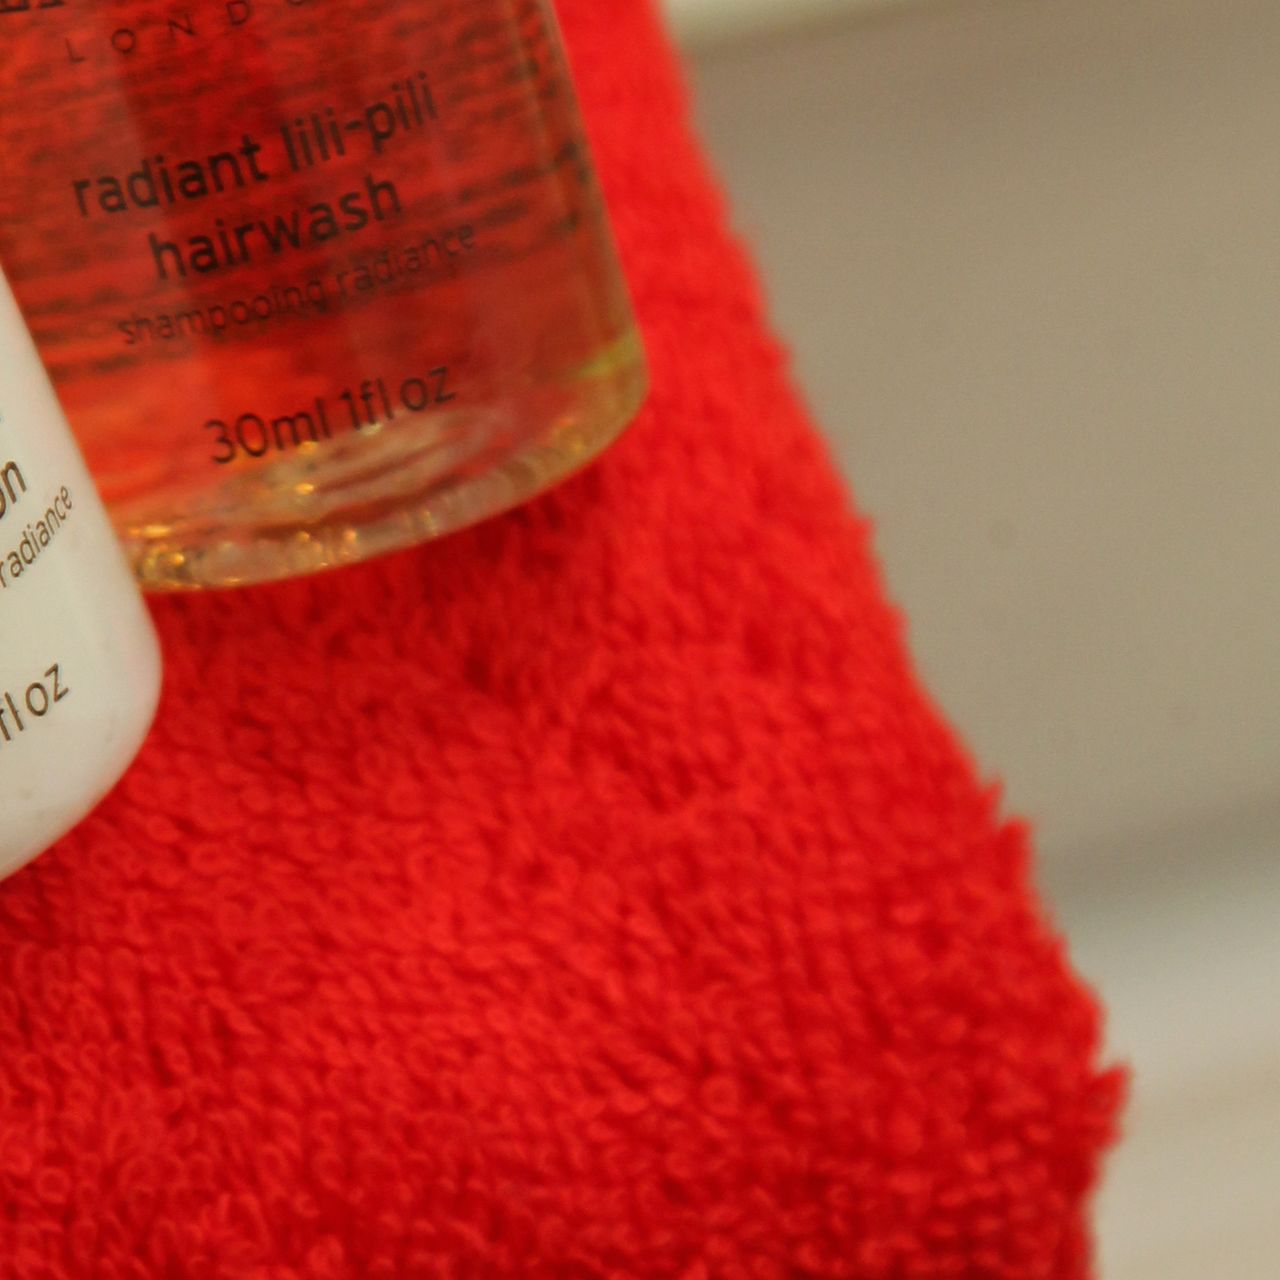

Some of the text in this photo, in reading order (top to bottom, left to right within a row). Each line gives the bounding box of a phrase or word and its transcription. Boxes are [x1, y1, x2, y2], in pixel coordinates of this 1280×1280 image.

[71, 70, 439, 218] radiant lili-pili
[147, 172, 402, 282] hairwash
[122, 222, 476, 344] shampooing radiance
[204, 397, 333, 465] 30ml
[399, 365, 458, 412] oz
[24, 663, 71, 718] oz
